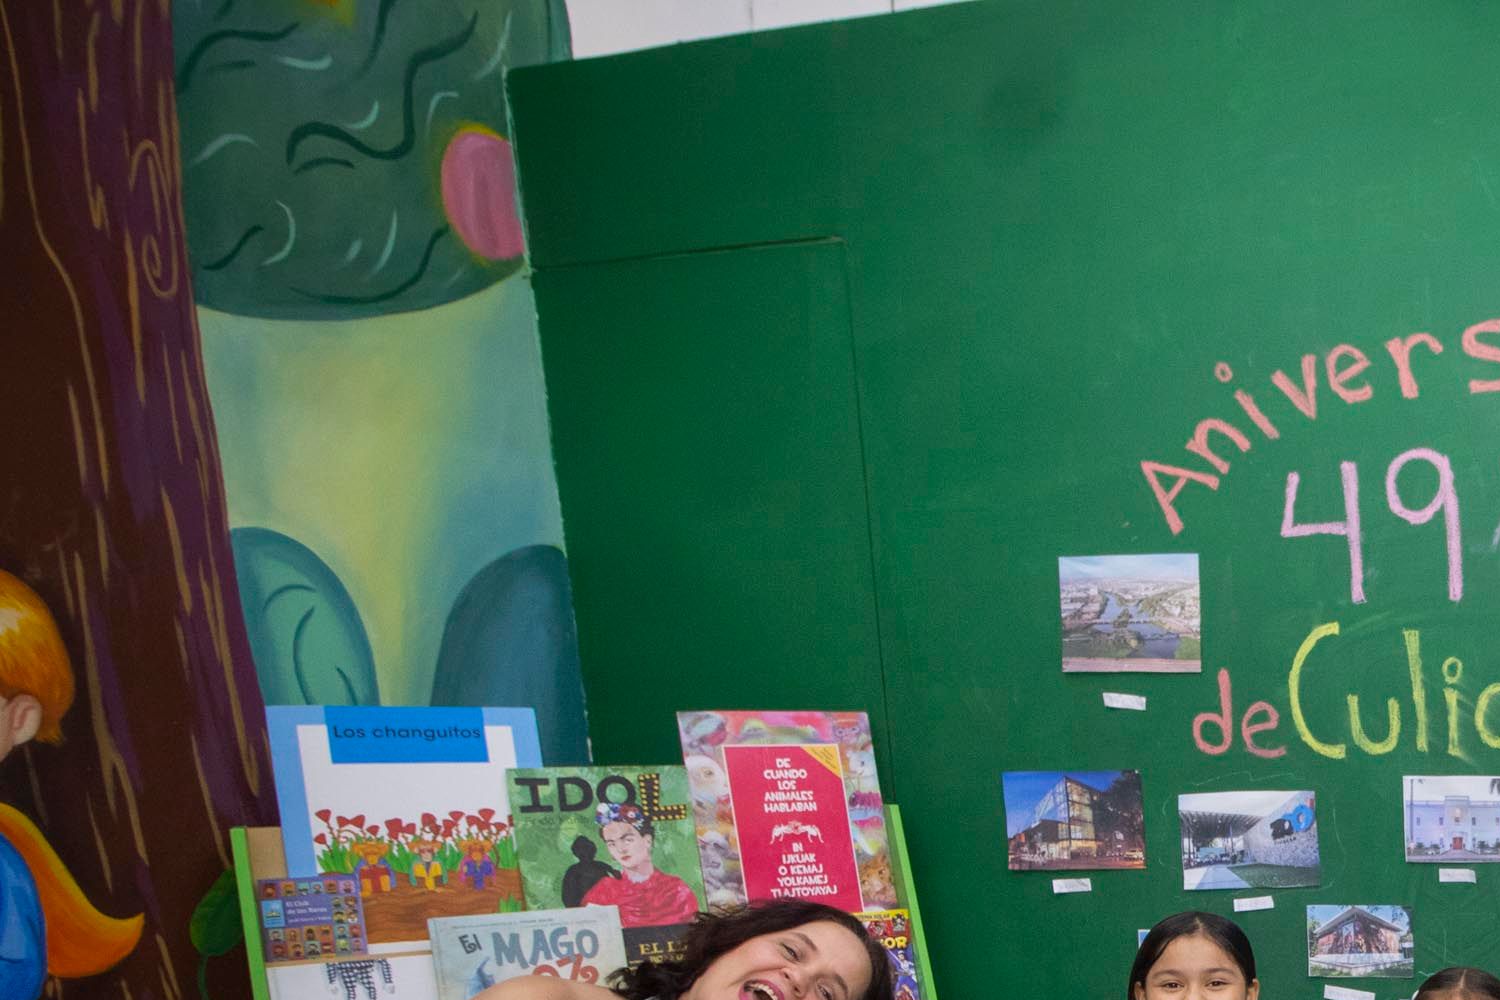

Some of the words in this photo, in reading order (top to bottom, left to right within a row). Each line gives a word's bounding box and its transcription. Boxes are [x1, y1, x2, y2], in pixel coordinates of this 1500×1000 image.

[1192, 668, 1287, 759] de
[333, 725, 365, 739] Los
[372, 725, 482, 741] changuitos
[776, 758, 791, 768] DE
[763, 768, 808, 779] CUANDO
[777, 780, 796, 790] LOS
[514, 773, 687, 821] IDOL
[764, 791, 814, 802] ANIMALES
[763, 802, 818, 814] HABLABAN
[792, 842, 804, 852] IN
[778, 866, 788, 875] O
[791, 864, 823, 876] KEMAJ
[458, 933, 482, 955] El
[490, 926, 600, 969] MAGO
[638, 941, 664, 955] EL
